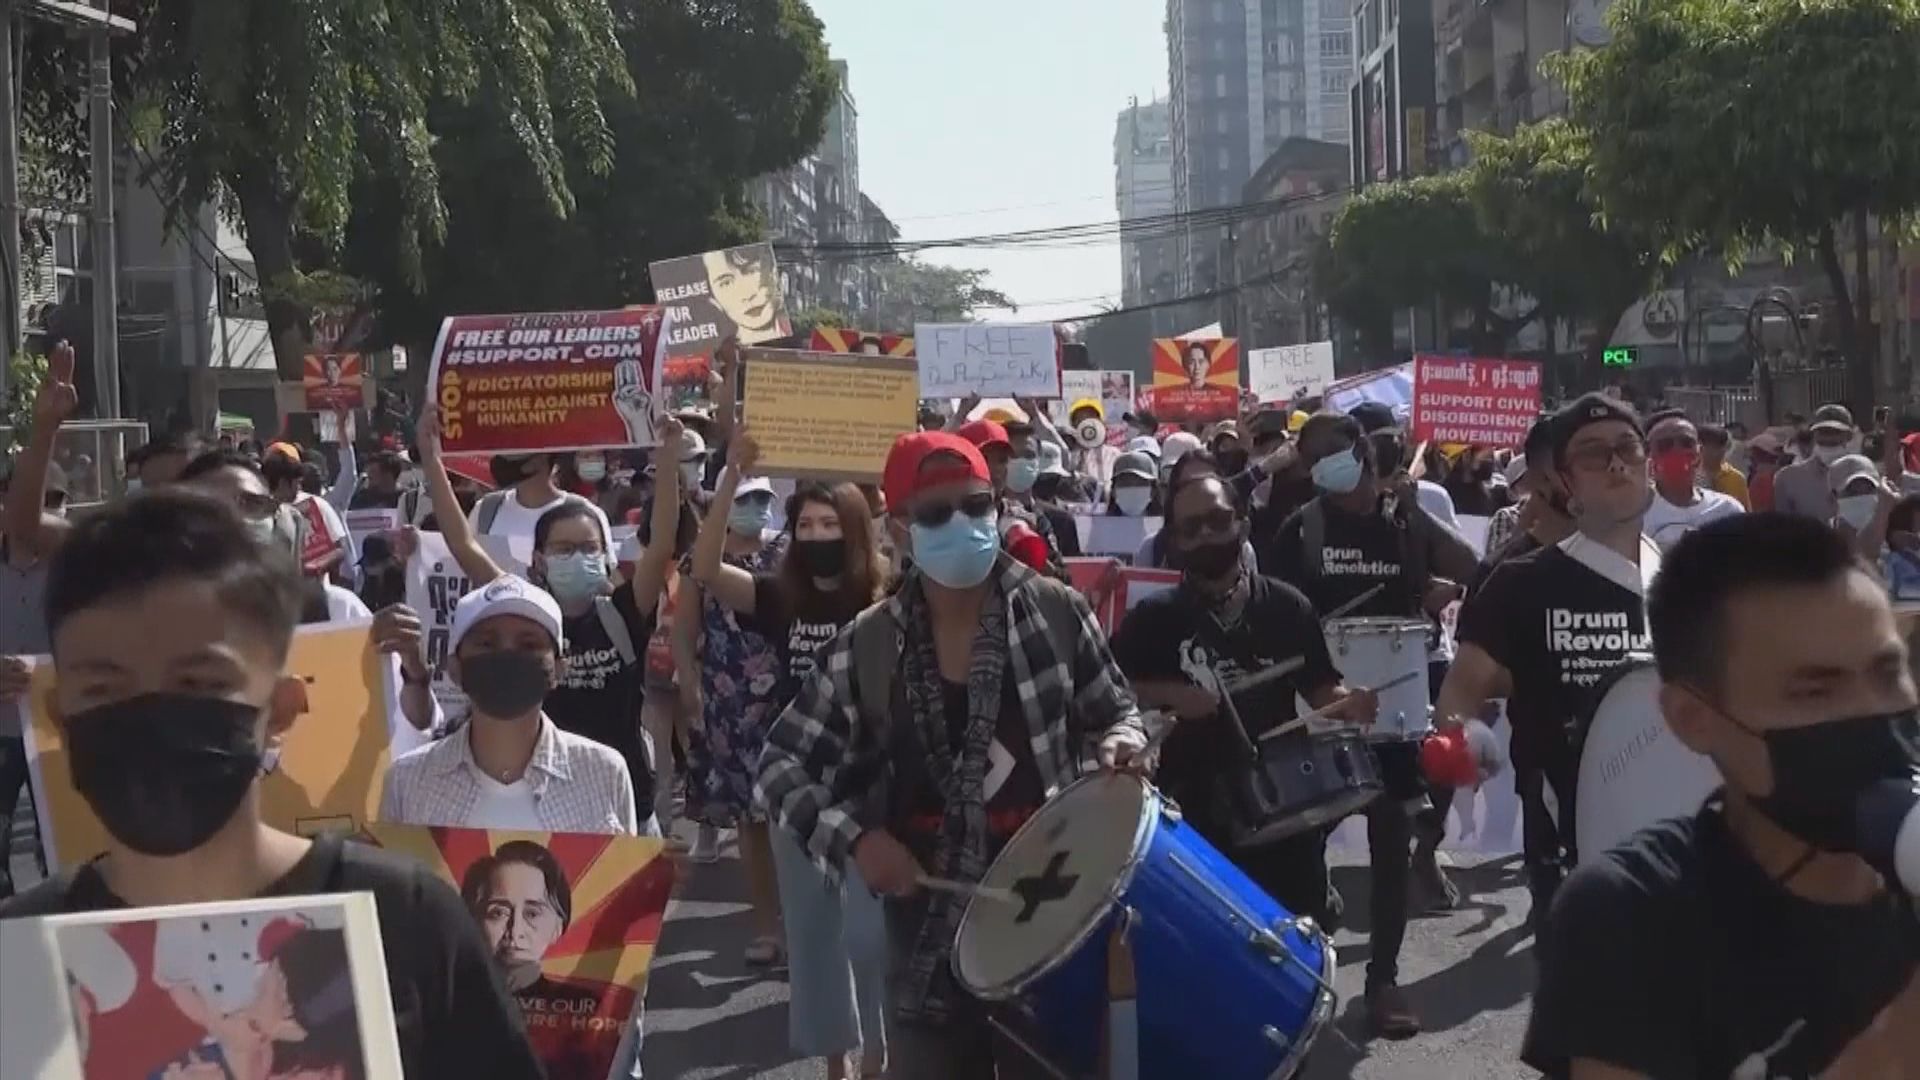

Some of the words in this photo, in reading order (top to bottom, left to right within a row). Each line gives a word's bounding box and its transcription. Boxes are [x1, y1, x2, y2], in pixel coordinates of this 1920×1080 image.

[656, 281, 709, 302] RELEASE
[671, 305, 692, 323] UR
[453, 330, 504, 347] FREE
[508, 328, 551, 345] OUR
[554, 325, 641, 343] LEADERS
[935, 327, 1033, 357] FREE
[446, 343, 642, 365] #SUPPORT_CDM
[1262, 346, 1314, 368] FREE
[1603, 350, 1632, 364] PCL
[466, 373, 613, 393] #DICTATORSHIP
[441, 370, 462, 440] STOP
[467, 400, 530, 413] #CRIME
[533, 393, 609, 409] AGAINST
[1420, 394, 1493, 409] SUPPORT
[1497, 399, 1538, 411] CIVIL
[477, 410, 568, 426] HUMANITY
[1420, 411, 1537, 427] DISOBEDIENCE
[1433, 428, 1521, 444] MOVEMENT
[1322, 546, 1363, 560] Drum
[1323, 561, 1401, 575] Revolution
[1552, 608, 1628, 629] Drum
[1600, 725, 1662, 784] Imperia
[520, 998, 545, 1011] VE
[551, 998, 596, 1013] OUR
